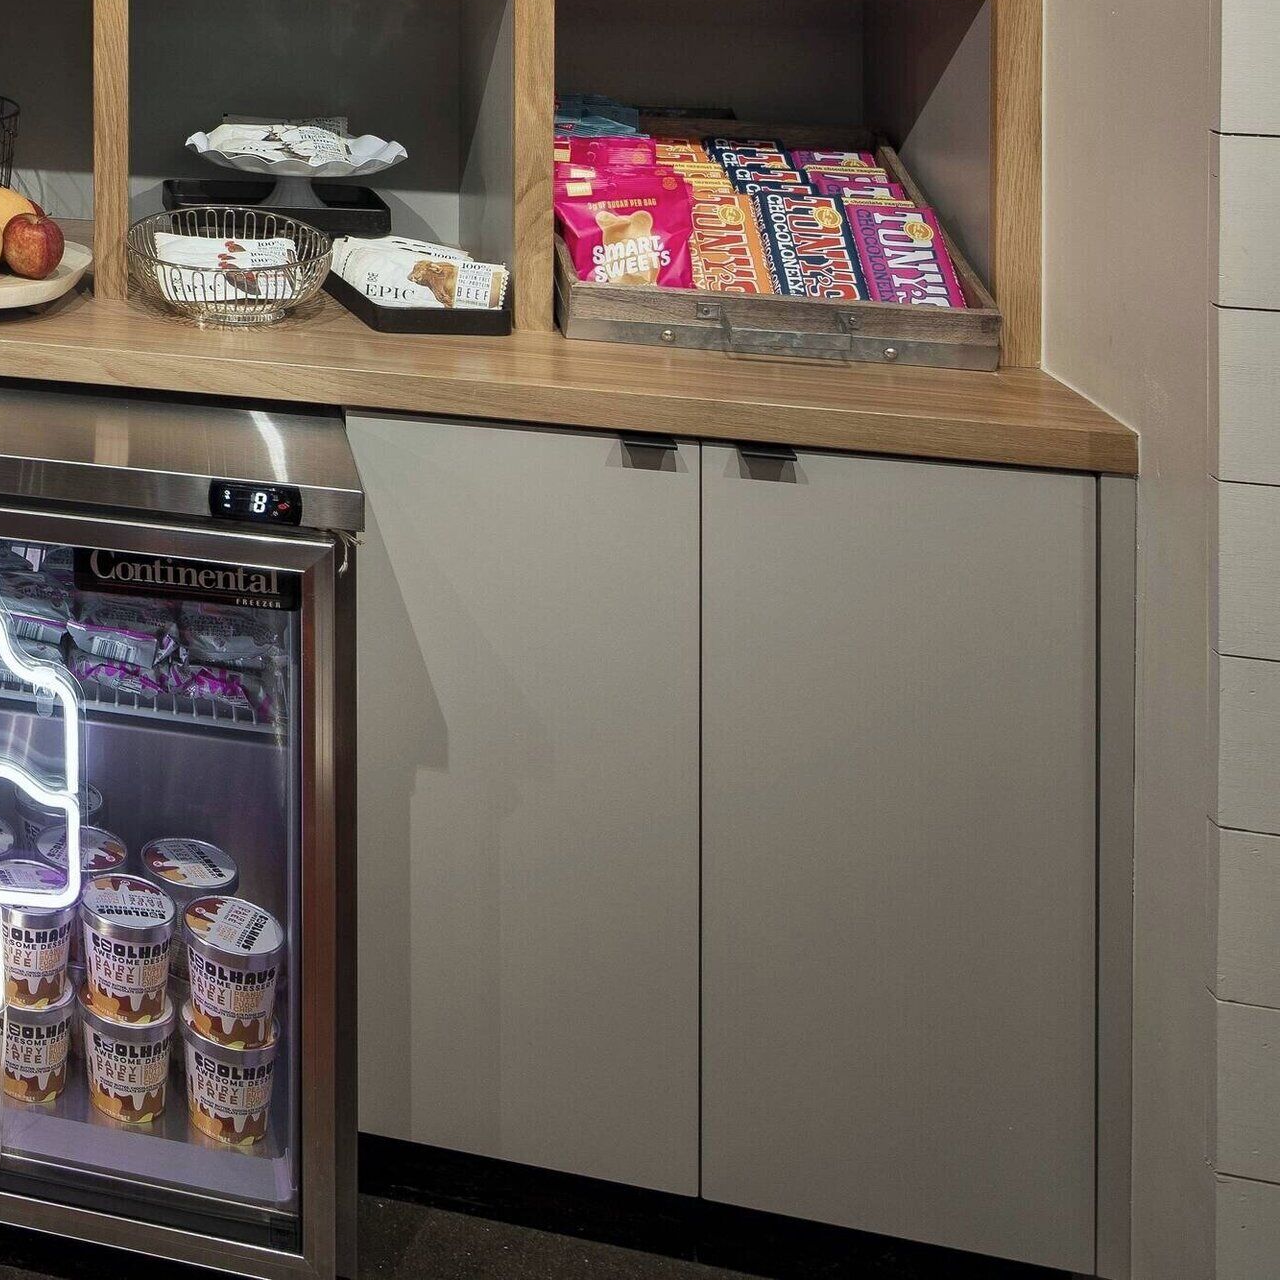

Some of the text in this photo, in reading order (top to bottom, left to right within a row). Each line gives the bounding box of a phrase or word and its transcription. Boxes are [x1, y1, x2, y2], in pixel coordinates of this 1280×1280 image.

[592, 235, 664, 266] SMART
[594, 251, 671, 284] SWEETS
[366, 284, 415, 300] EPIC
[457, 286, 490, 301] BEEF
[90, 548, 281, 595] Continental
[95, 954, 136, 974] DAIRY
[96, 965, 135, 984] FREE
[196, 1065, 245, 1087] AWESOME
